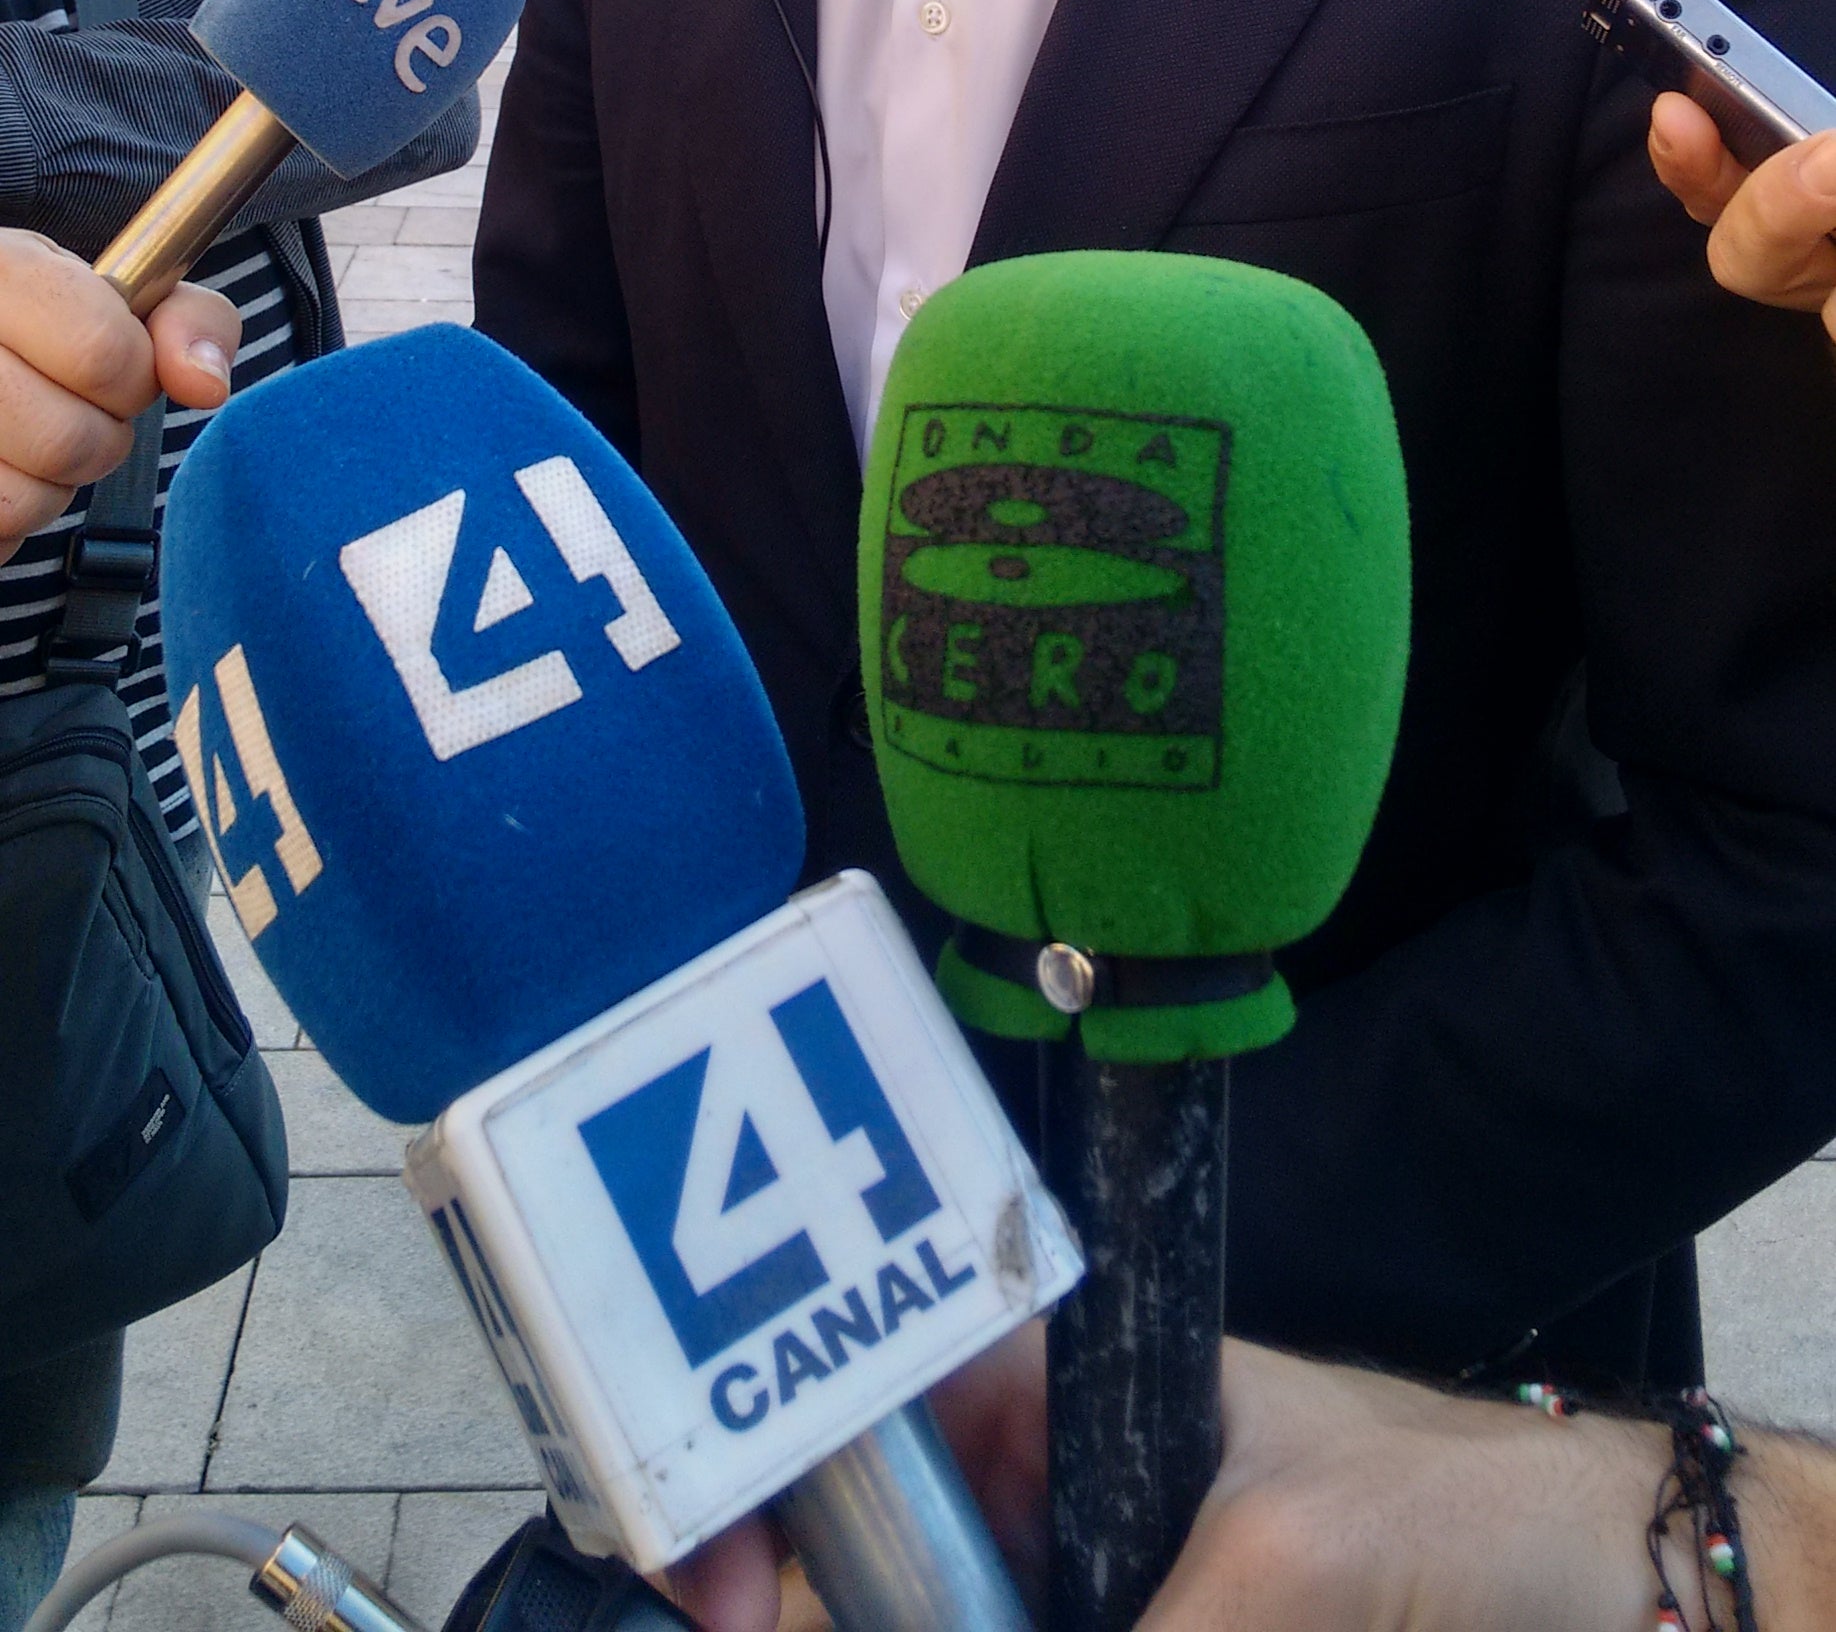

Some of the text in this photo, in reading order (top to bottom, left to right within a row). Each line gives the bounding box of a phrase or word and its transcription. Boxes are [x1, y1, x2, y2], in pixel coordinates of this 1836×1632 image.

[923, 418, 1177, 466] ONDA
[339, 454, 682, 762] 4
[577, 976, 942, 1370] 4
[709, 1237, 977, 1434] CANAL
